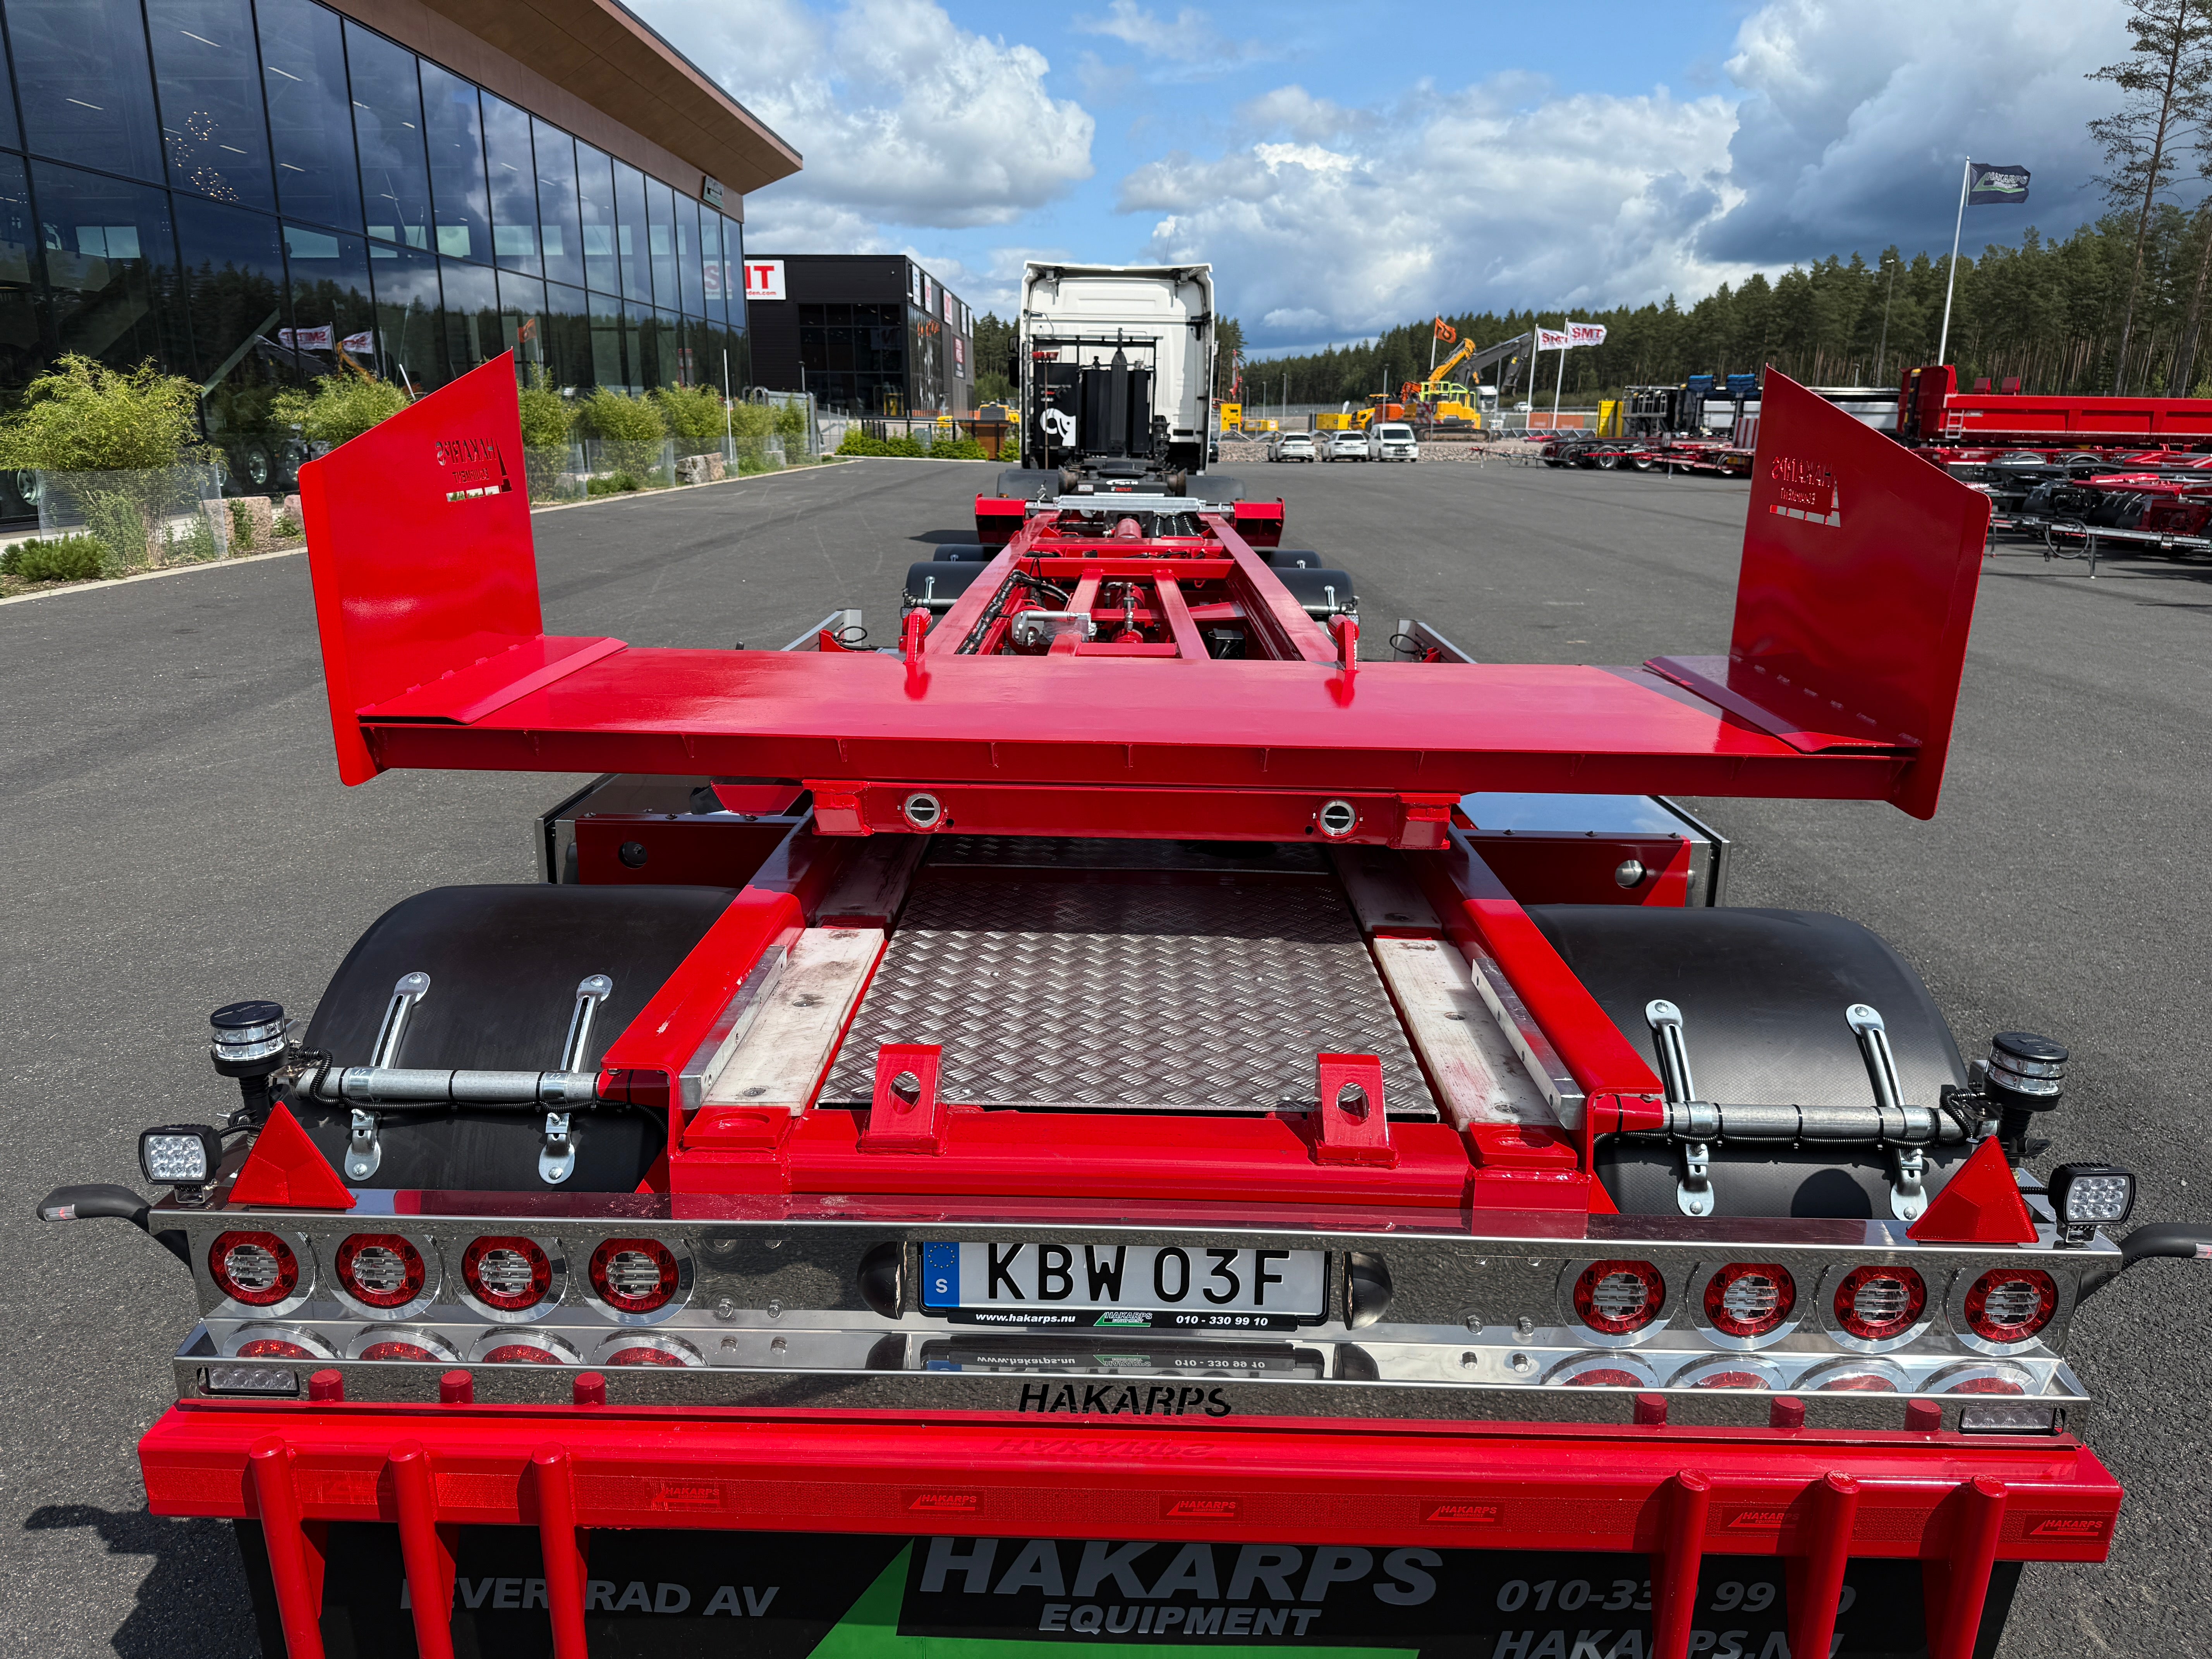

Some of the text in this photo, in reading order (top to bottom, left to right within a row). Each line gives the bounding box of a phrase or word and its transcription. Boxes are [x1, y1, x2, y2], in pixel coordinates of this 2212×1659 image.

[1572, 327, 1604, 340] SMT
[988, 1243, 1127, 1302] KBW
[1154, 1247, 1290, 1305] 03F
[936, 1278, 948, 1293] S
[975, 1313, 1076, 1324] www.hakarps.nu
[1176, 1315, 1199, 1324] 010
[1209, 1316, 1231, 1325] 330
[1235, 1317, 1250, 1325] 99
[1254, 1317, 1268, 1326] 10
[1018, 1383, 1232, 1417] HAKARPS
[666, 1487, 719, 1496] HAKARPS
[921, 1494, 977, 1503] HAKARPS
[1180, 1501, 1236, 1509] HAKARPS
[1441, 1506, 1497, 1514] HAKARPS
[1742, 1512, 1800, 1520] HAKARPS
[2045, 1520, 2103, 1528] HAKARPS
[919, 1537, 1443, 1606] HAKARPS
[400, 1577, 780, 1617] VERRAD AV
[1496, 1580, 1699, 1612] 010-33
[1710, 1581, 1776, 1612] 99
[1038, 1603, 1322, 1635] EQUIPMENT
[1491, 1629, 1845, 1659] HAKAPS.N
